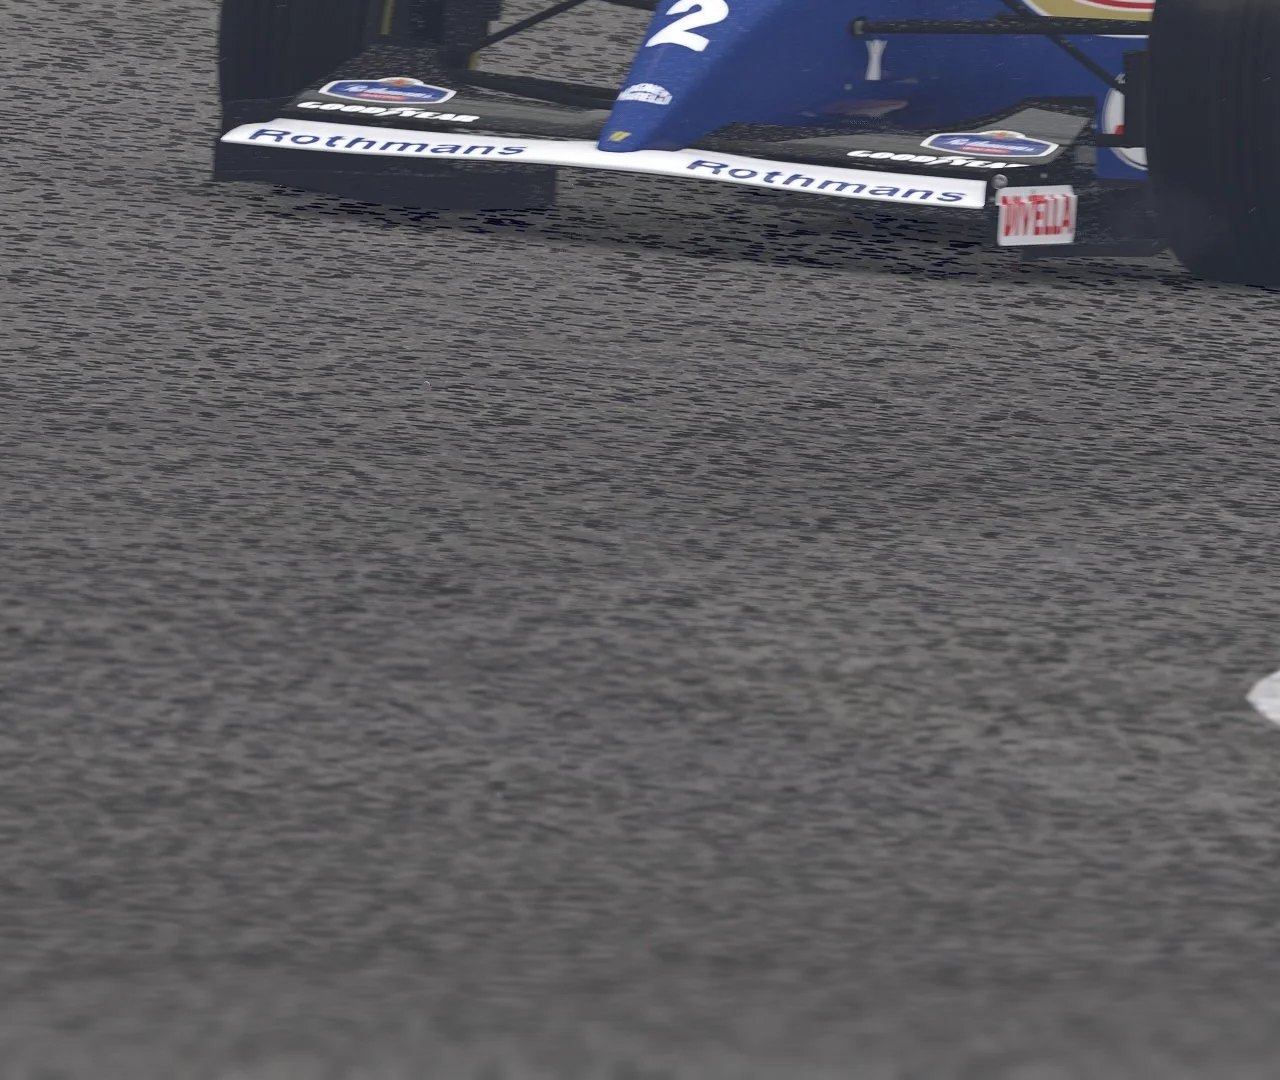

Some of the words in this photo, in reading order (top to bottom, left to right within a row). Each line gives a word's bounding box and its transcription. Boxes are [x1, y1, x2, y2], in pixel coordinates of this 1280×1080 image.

[296, 100, 481, 123] GOODYEAR
[248, 128, 529, 156] Rothmans
[686, 159, 969, 203] Rothmans
